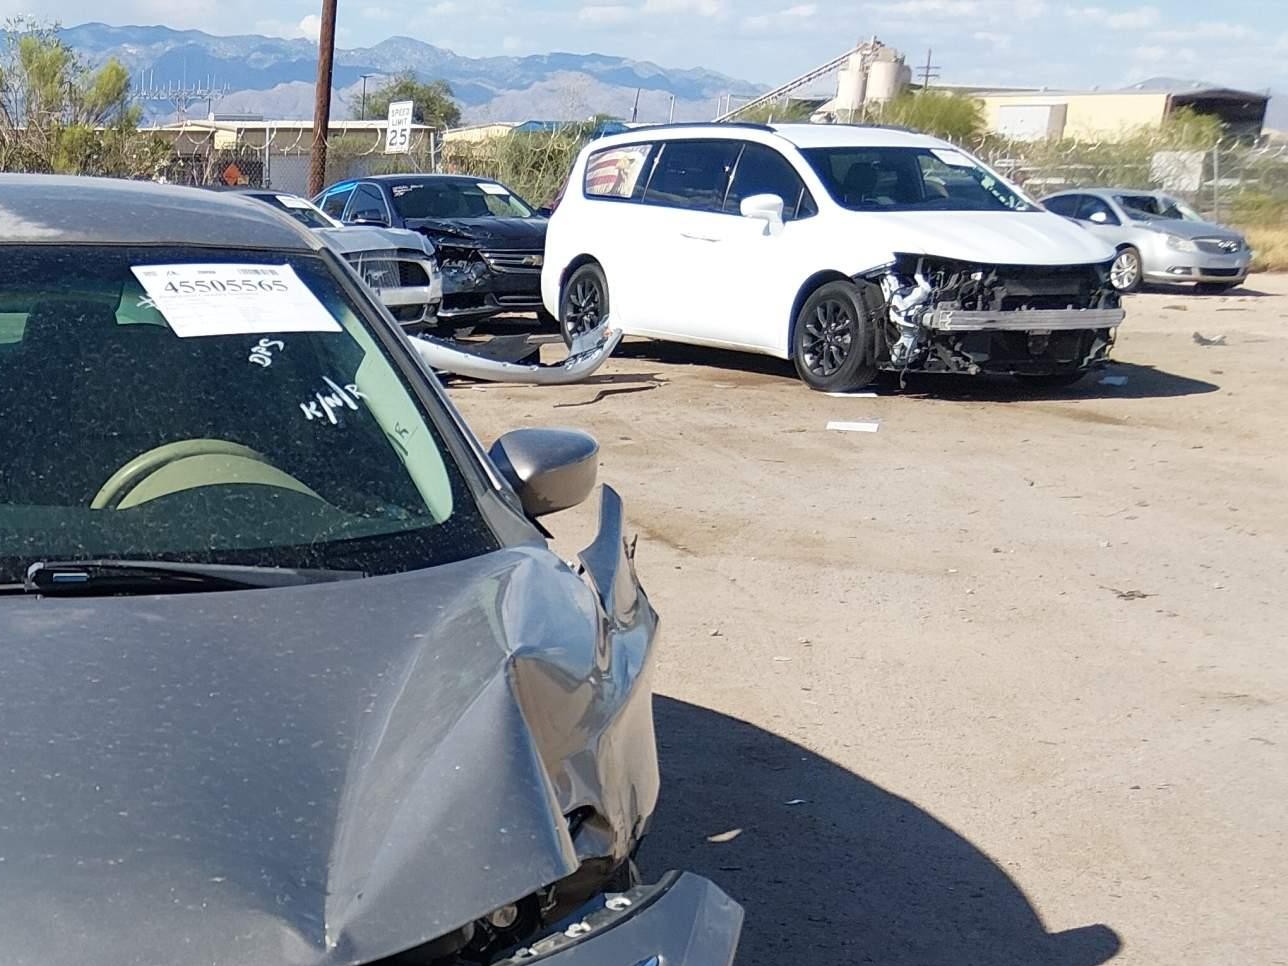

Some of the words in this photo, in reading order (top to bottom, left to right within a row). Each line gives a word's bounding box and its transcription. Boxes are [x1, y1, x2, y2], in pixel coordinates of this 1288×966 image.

[391, 107, 410, 117] SPEED
[391, 117, 408, 127] LIMIT
[389, 128, 407, 146] 25
[164, 279, 289, 294] 45505565
[248, 338, 285, 368] DPS
